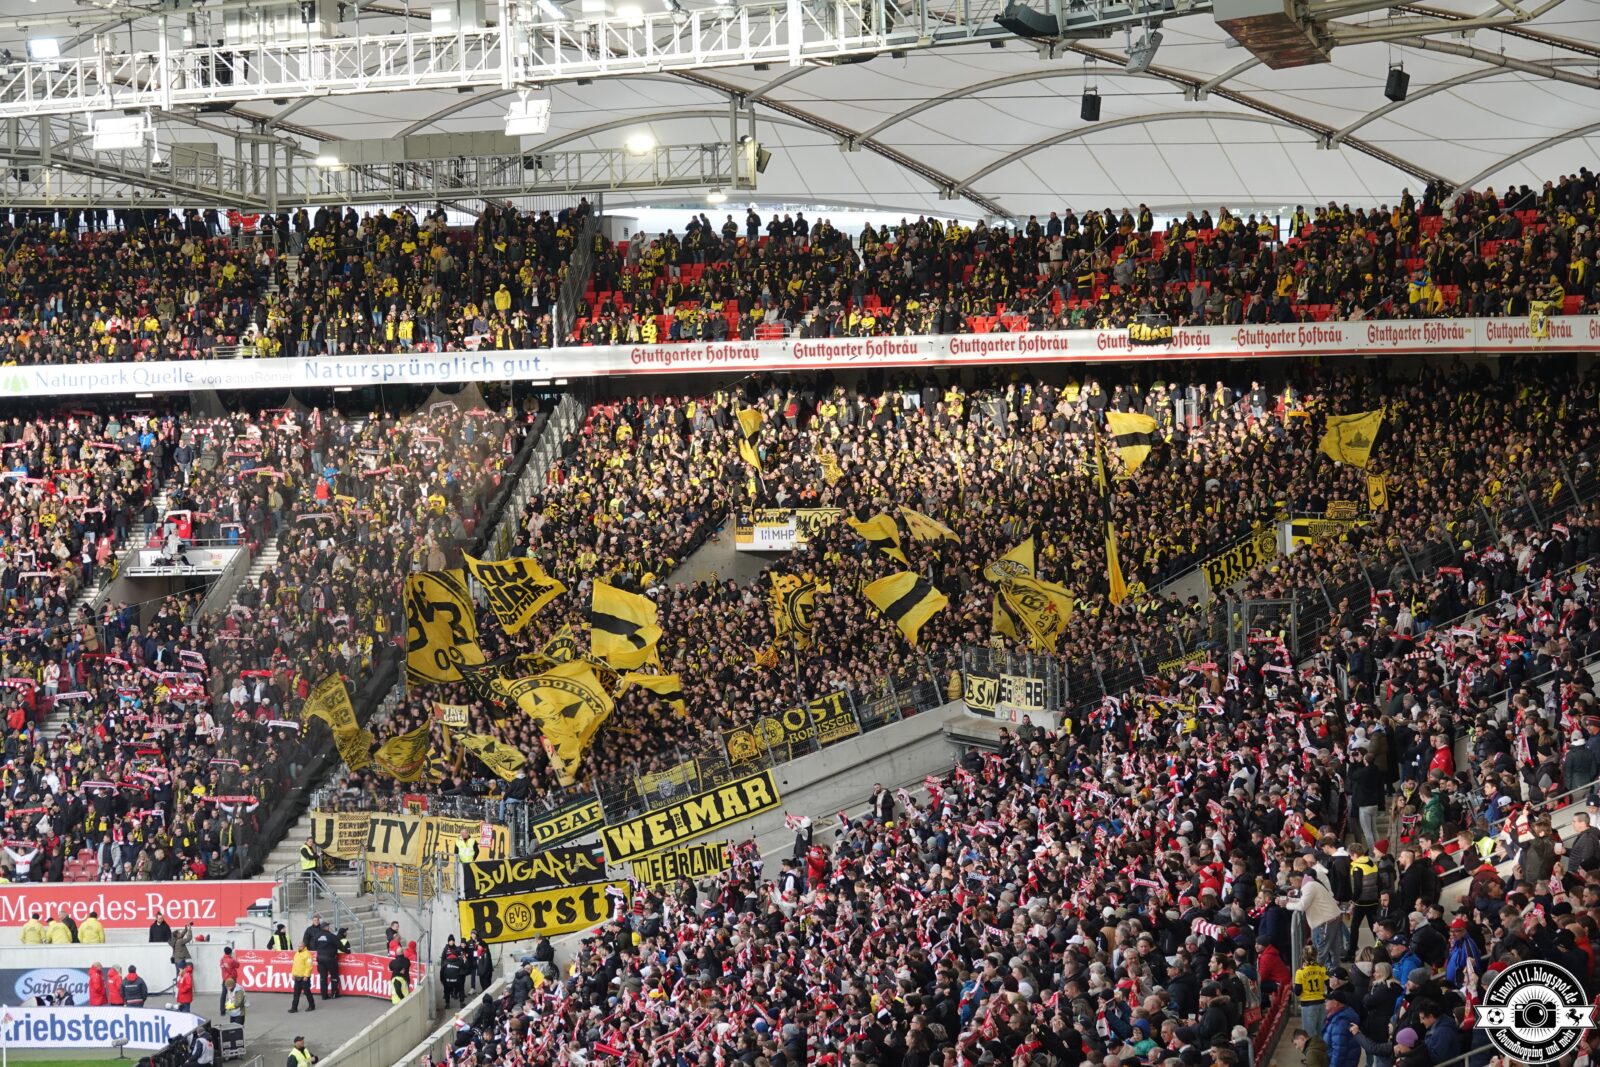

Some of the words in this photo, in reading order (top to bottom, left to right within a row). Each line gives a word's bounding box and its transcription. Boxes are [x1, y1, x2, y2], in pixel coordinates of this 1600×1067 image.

[1165, 330, 1211, 351] ofbräu
[1238, 328, 1296, 349] Stuttgarter
[1298, 325, 1342, 347] Hofbräu
[1487, 321, 1531, 344] Stuttgarte
[631, 346, 703, 366] Stuttgarter
[705, 343, 760, 365] Hofbräu
[793, 343, 862, 363] Stuttgarter
[865, 340, 918, 360] Hofbräu
[949, 337, 1019, 357] Stuttgarter
[1021, 334, 1068, 355] Hofbräu
[36, 369, 128, 389] Naturpark
[133, 366, 194, 386] Quelle
[201, 375, 222, 385] von
[305, 356, 494, 381] Natursprünglich
[503, 355, 549, 377] gut.
[772, 529, 795, 540] MHP
[1207, 542, 1257, 586] BRB
[783, 690, 846, 732] OST
[607, 776, 772, 856] WEIMAR
[311, 818, 419, 856] UITY
[633, 845, 733, 885] MEERANE
[0, 892, 216, 922] Mercedes-Benz
[1308, 978, 1320, 993] 11
